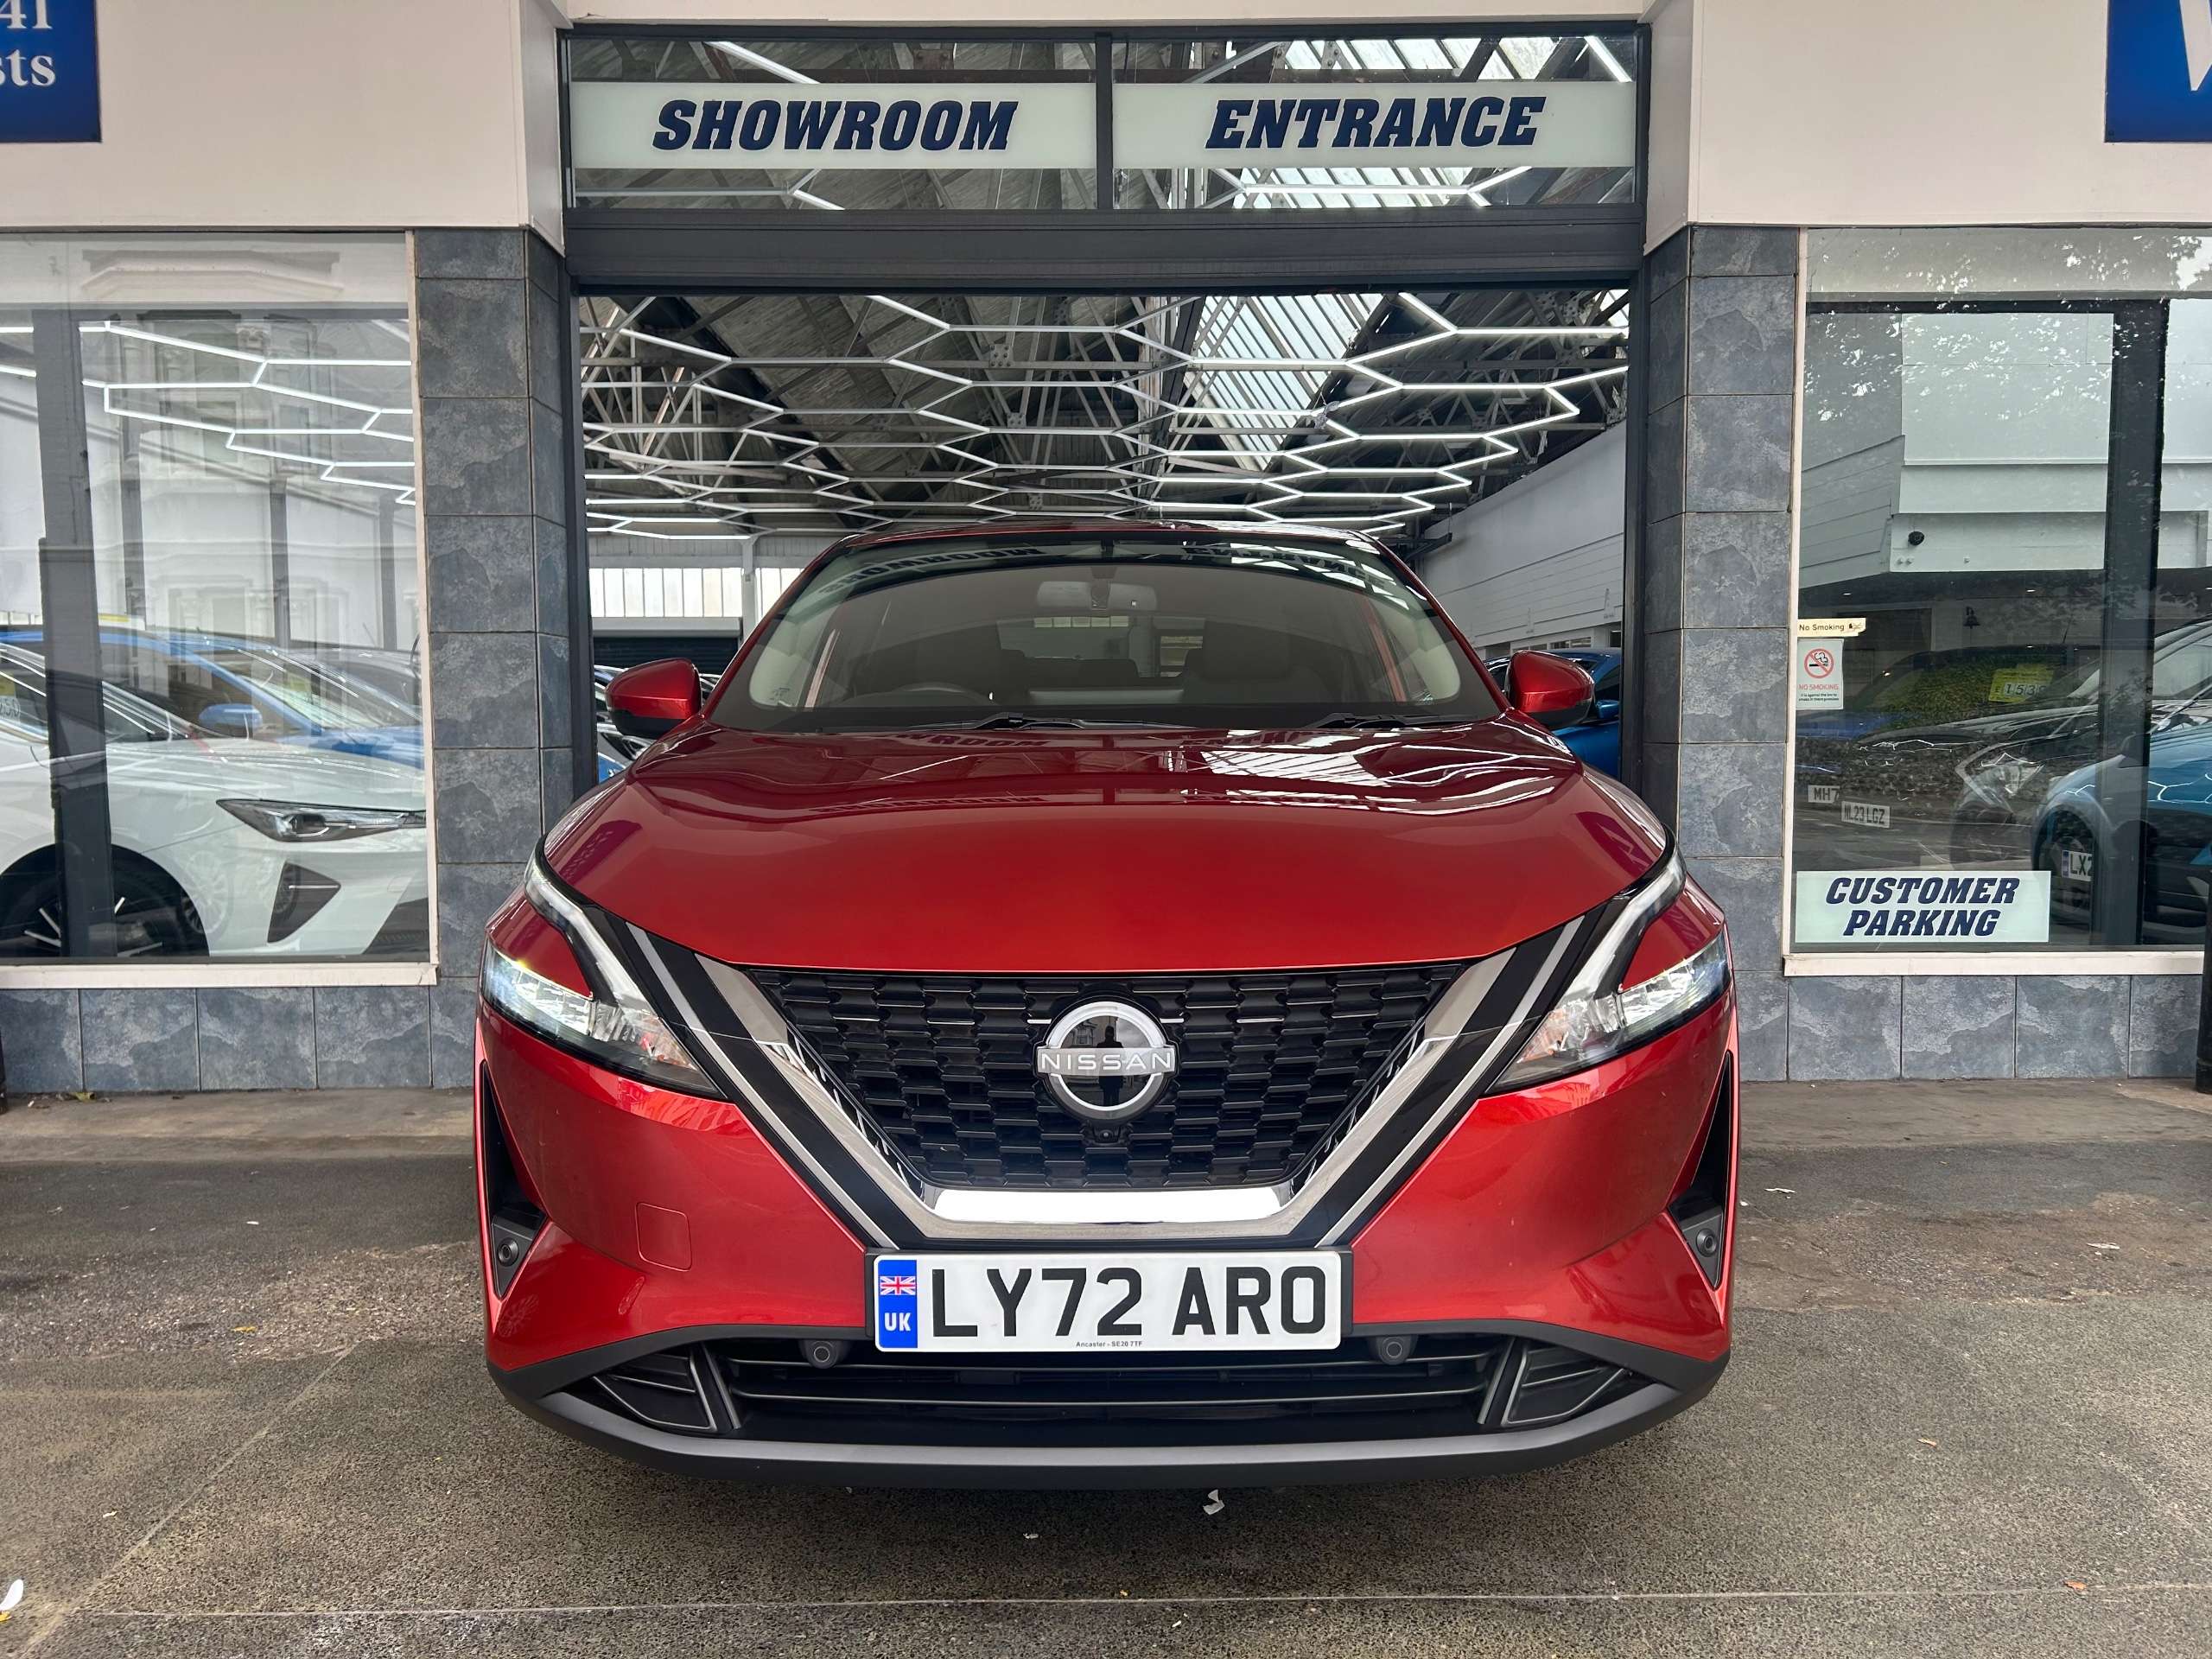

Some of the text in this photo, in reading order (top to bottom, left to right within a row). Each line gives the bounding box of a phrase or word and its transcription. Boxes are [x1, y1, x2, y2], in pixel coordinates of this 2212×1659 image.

[0, 49, 55, 86] ts
[652, 96, 1547, 151] SHOWROOM ENTRANCE
[1812, 623, 1845, 632] Smoking
[1826, 877, 2020, 904] CUSTOMER
[1842, 910, 2001, 937] PARKING
[1041, 1052, 1171, 1071] NISSAN
[932, 1266, 1326, 1337] LY72 ARO
[884, 1312, 912, 1332] UK
